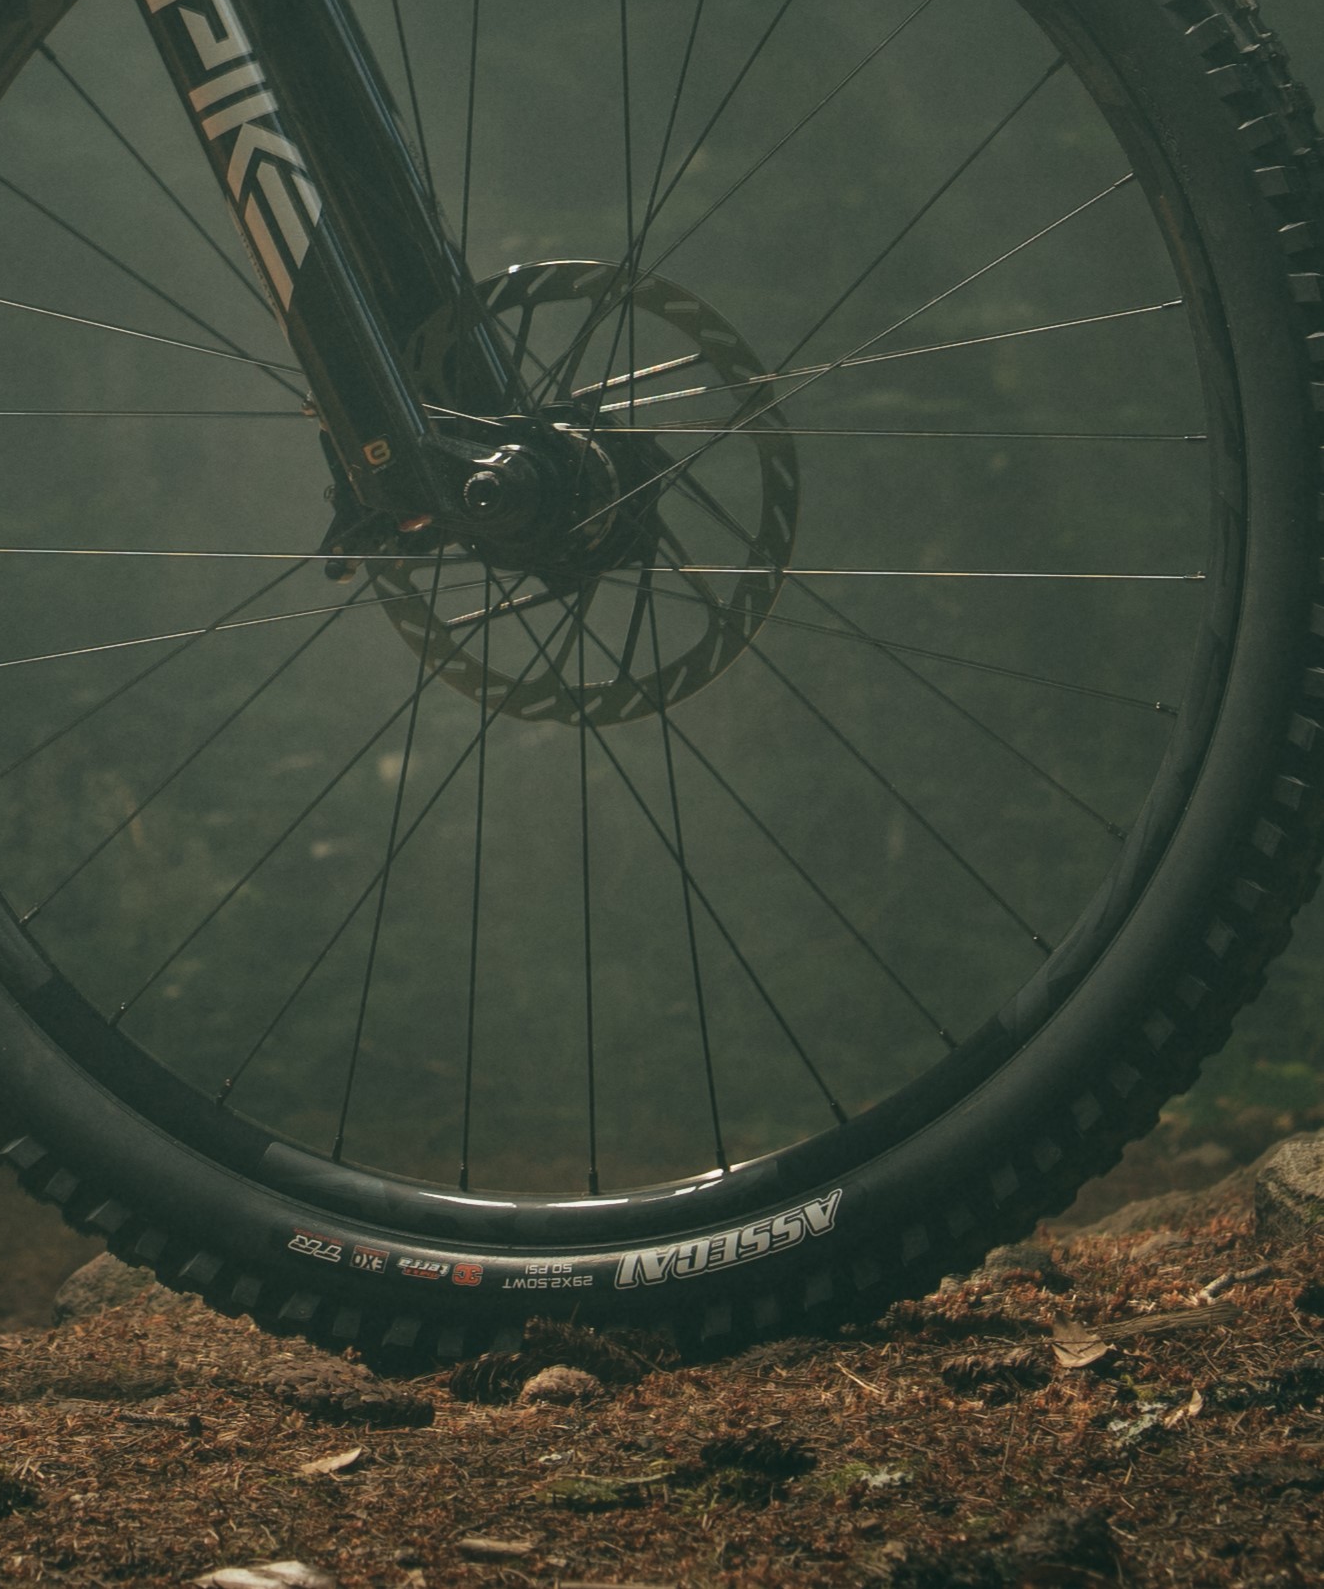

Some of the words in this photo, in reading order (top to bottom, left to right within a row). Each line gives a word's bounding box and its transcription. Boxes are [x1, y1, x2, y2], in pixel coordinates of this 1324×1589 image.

[288, 1234, 343, 1263] TR
[614, 1188, 843, 1290] ASSEGAI
[352, 1253, 385, 1273] EXO
[398, 1256, 450, 1277] terra
[524, 1263, 549, 1274] PSI
[551, 1263, 573, 1274] 50
[502, 1274, 593, 1289] 29X2.50WT
